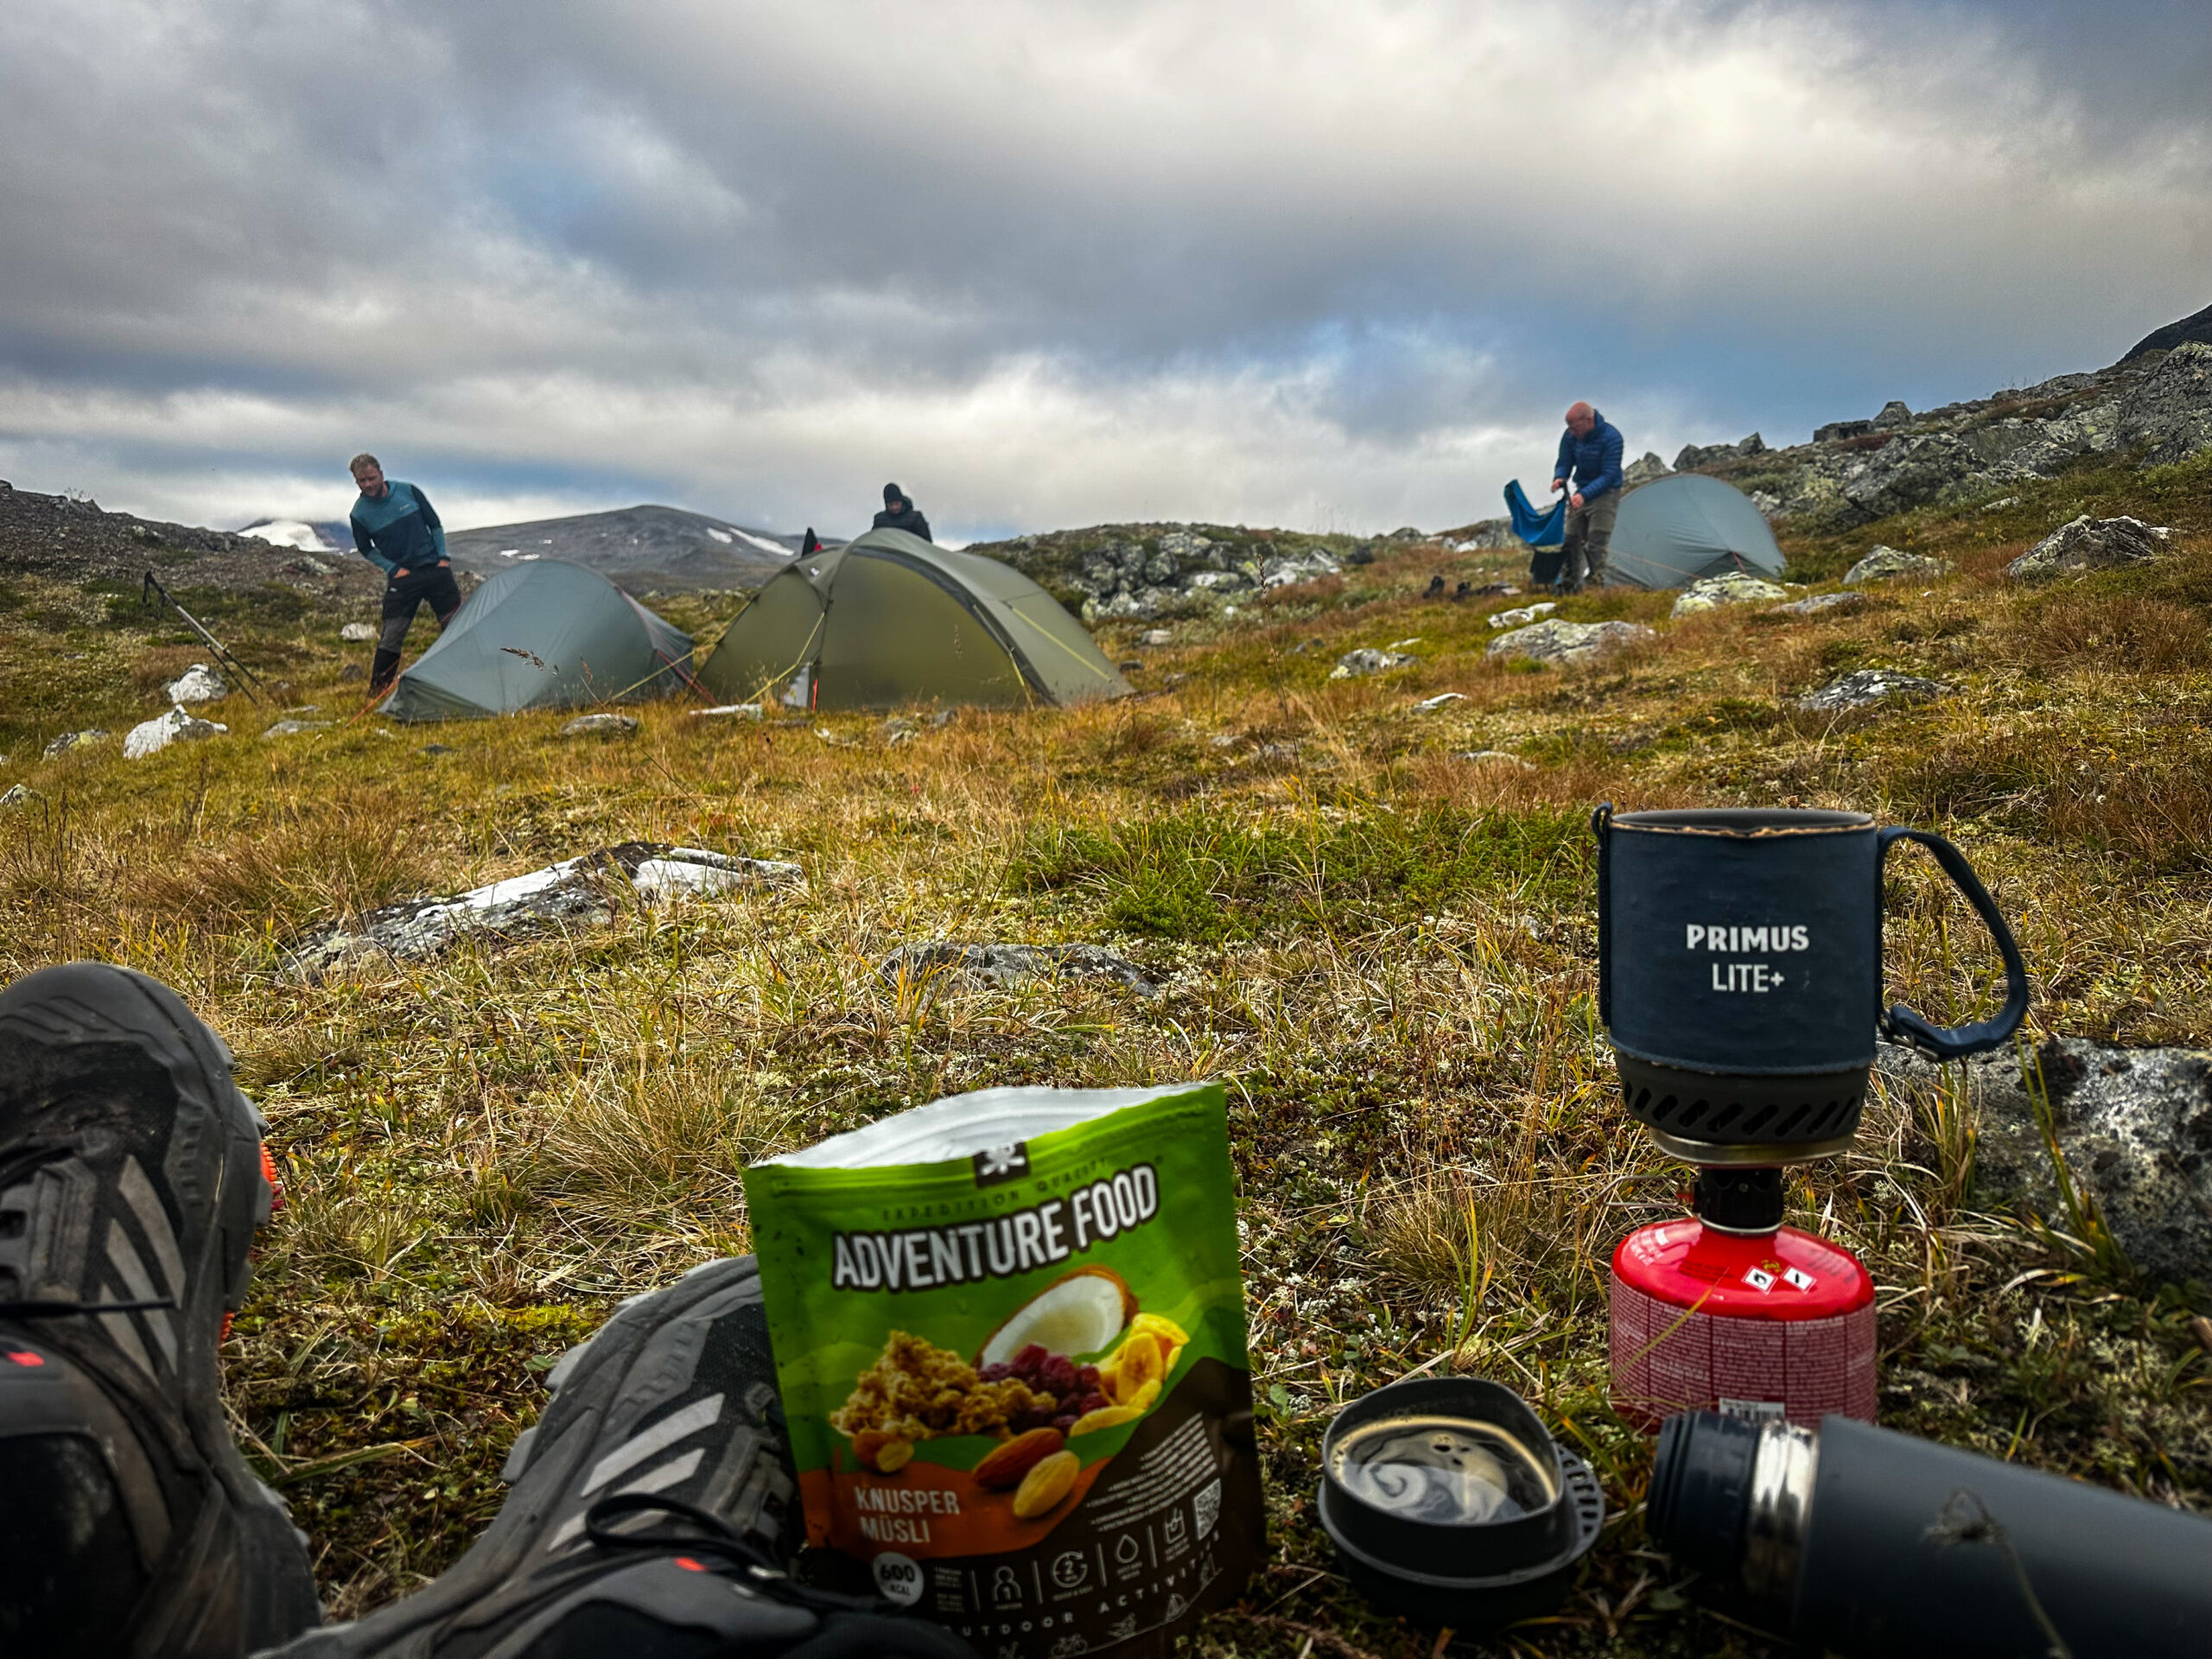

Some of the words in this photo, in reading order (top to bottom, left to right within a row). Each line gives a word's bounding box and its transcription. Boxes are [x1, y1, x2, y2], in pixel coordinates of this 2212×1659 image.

[1687, 924, 1809, 952] PRIMUS
[1712, 963, 1785, 992] LITE+
[882, 1190, 1020, 1221] EXPEDITION
[1038, 1159, 1108, 1192] QUALITY
[833, 1200, 1070, 1288] ADVENTURE
[1071, 1166, 1157, 1248] FOOD
[855, 1486, 961, 1516] KNUSPER
[860, 1515, 931, 1543] MÜSLI
[880, 1563, 916, 1584] 600
[889, 1584, 912, 1598] KCAL
